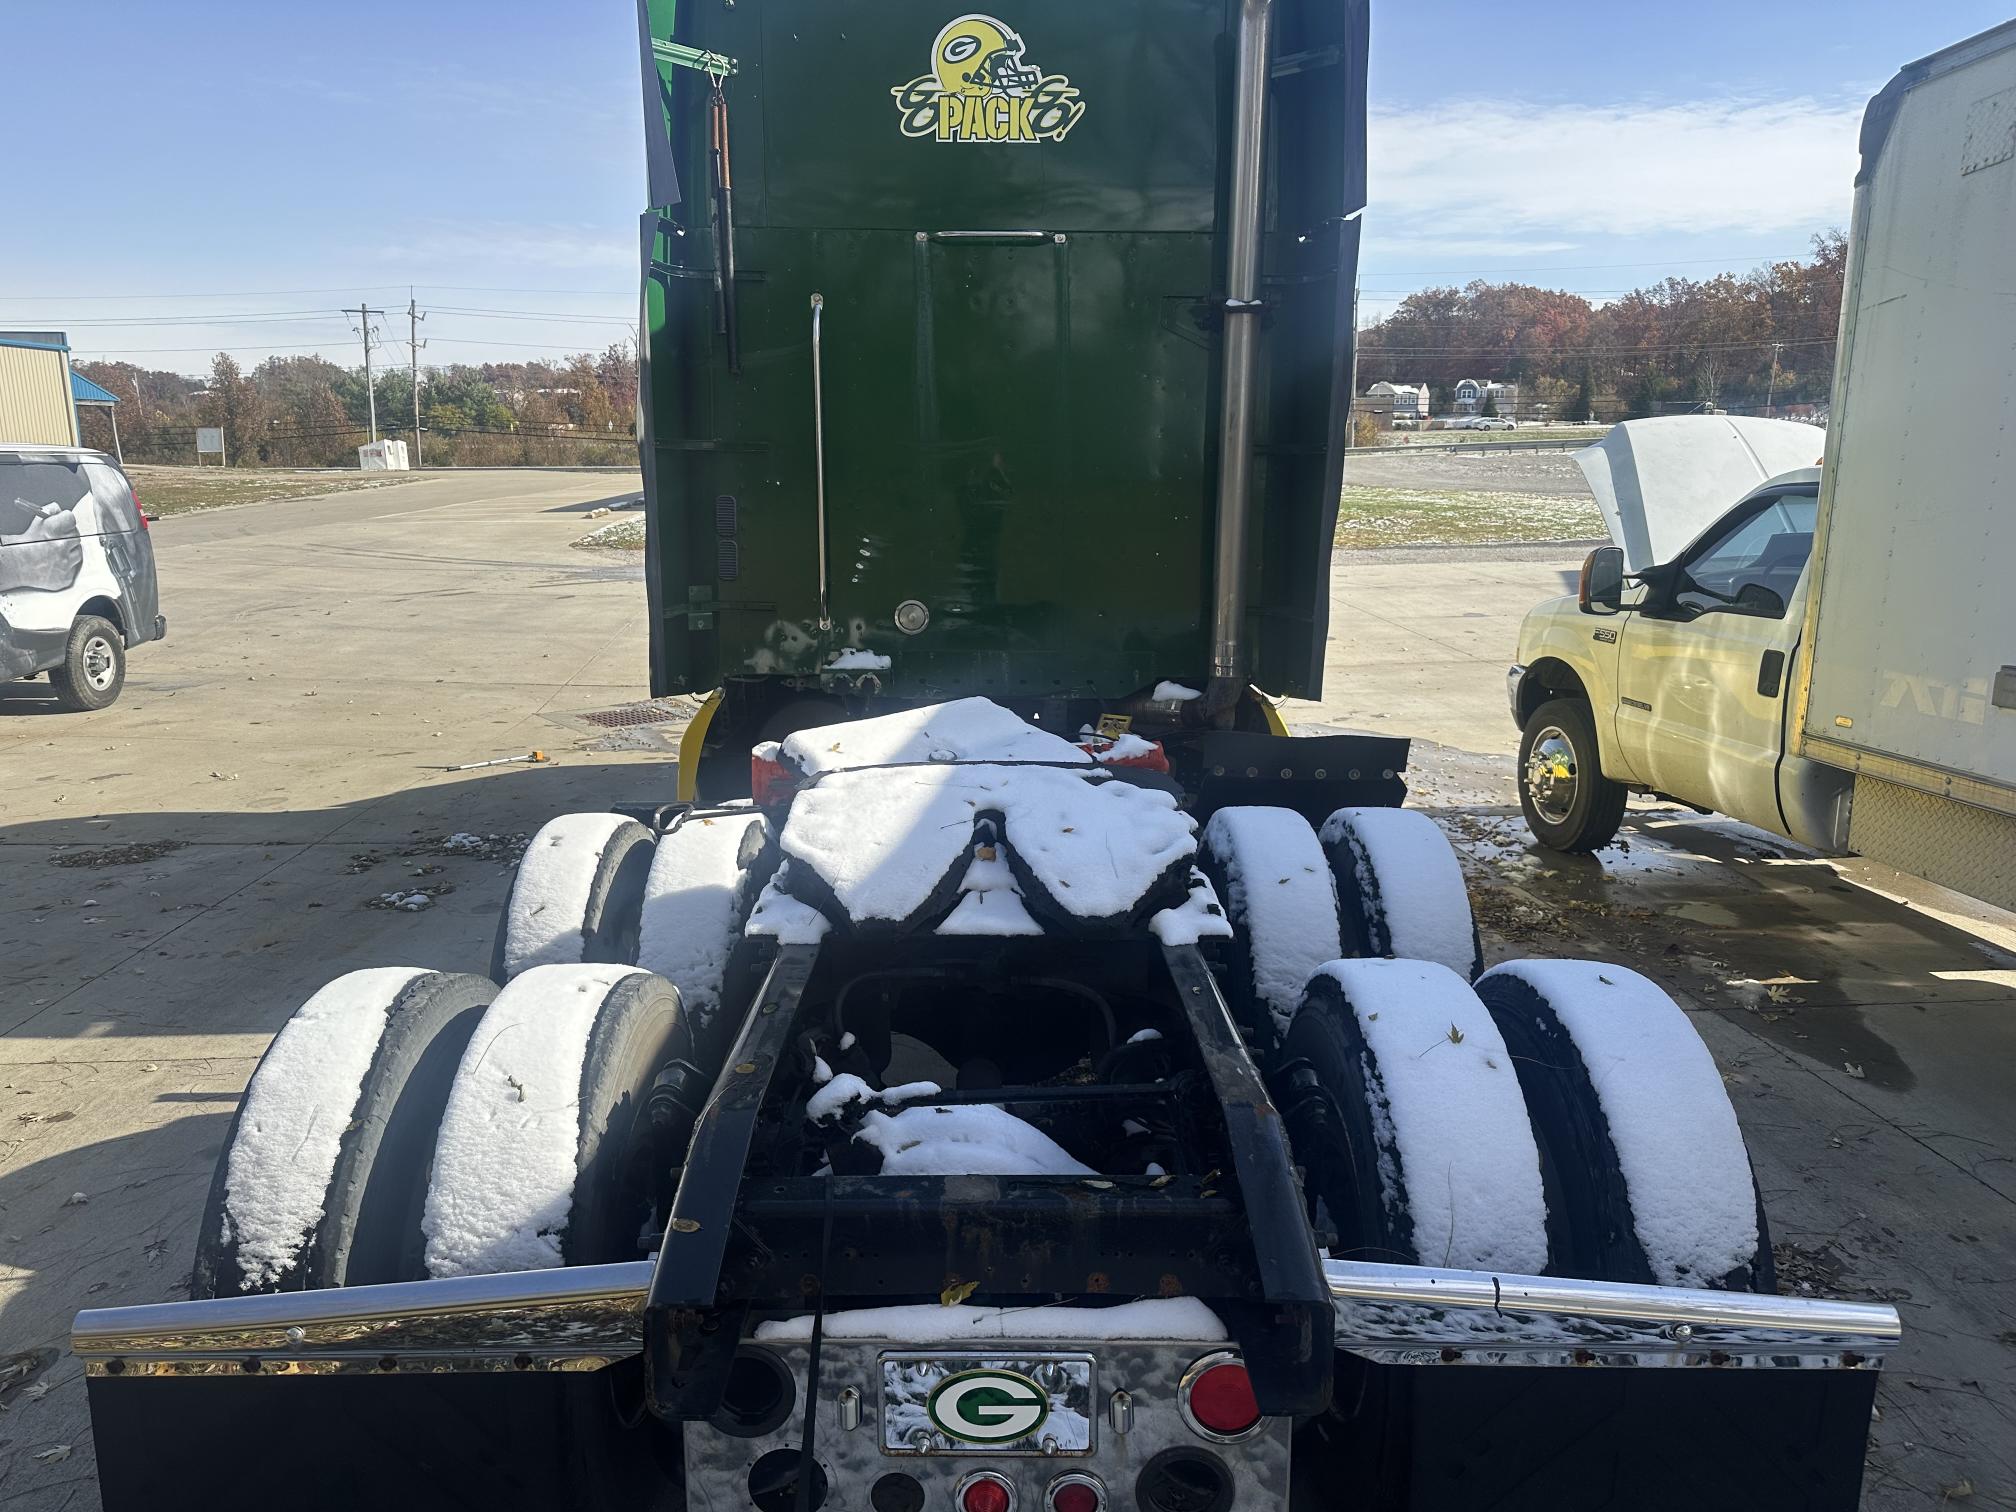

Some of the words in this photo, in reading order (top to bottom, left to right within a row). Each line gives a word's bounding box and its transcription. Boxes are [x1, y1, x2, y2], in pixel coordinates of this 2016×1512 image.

[944, 37, 979, 62] G
[938, 96, 1036, 140] PACK
[935, 1377, 1041, 1437] G
